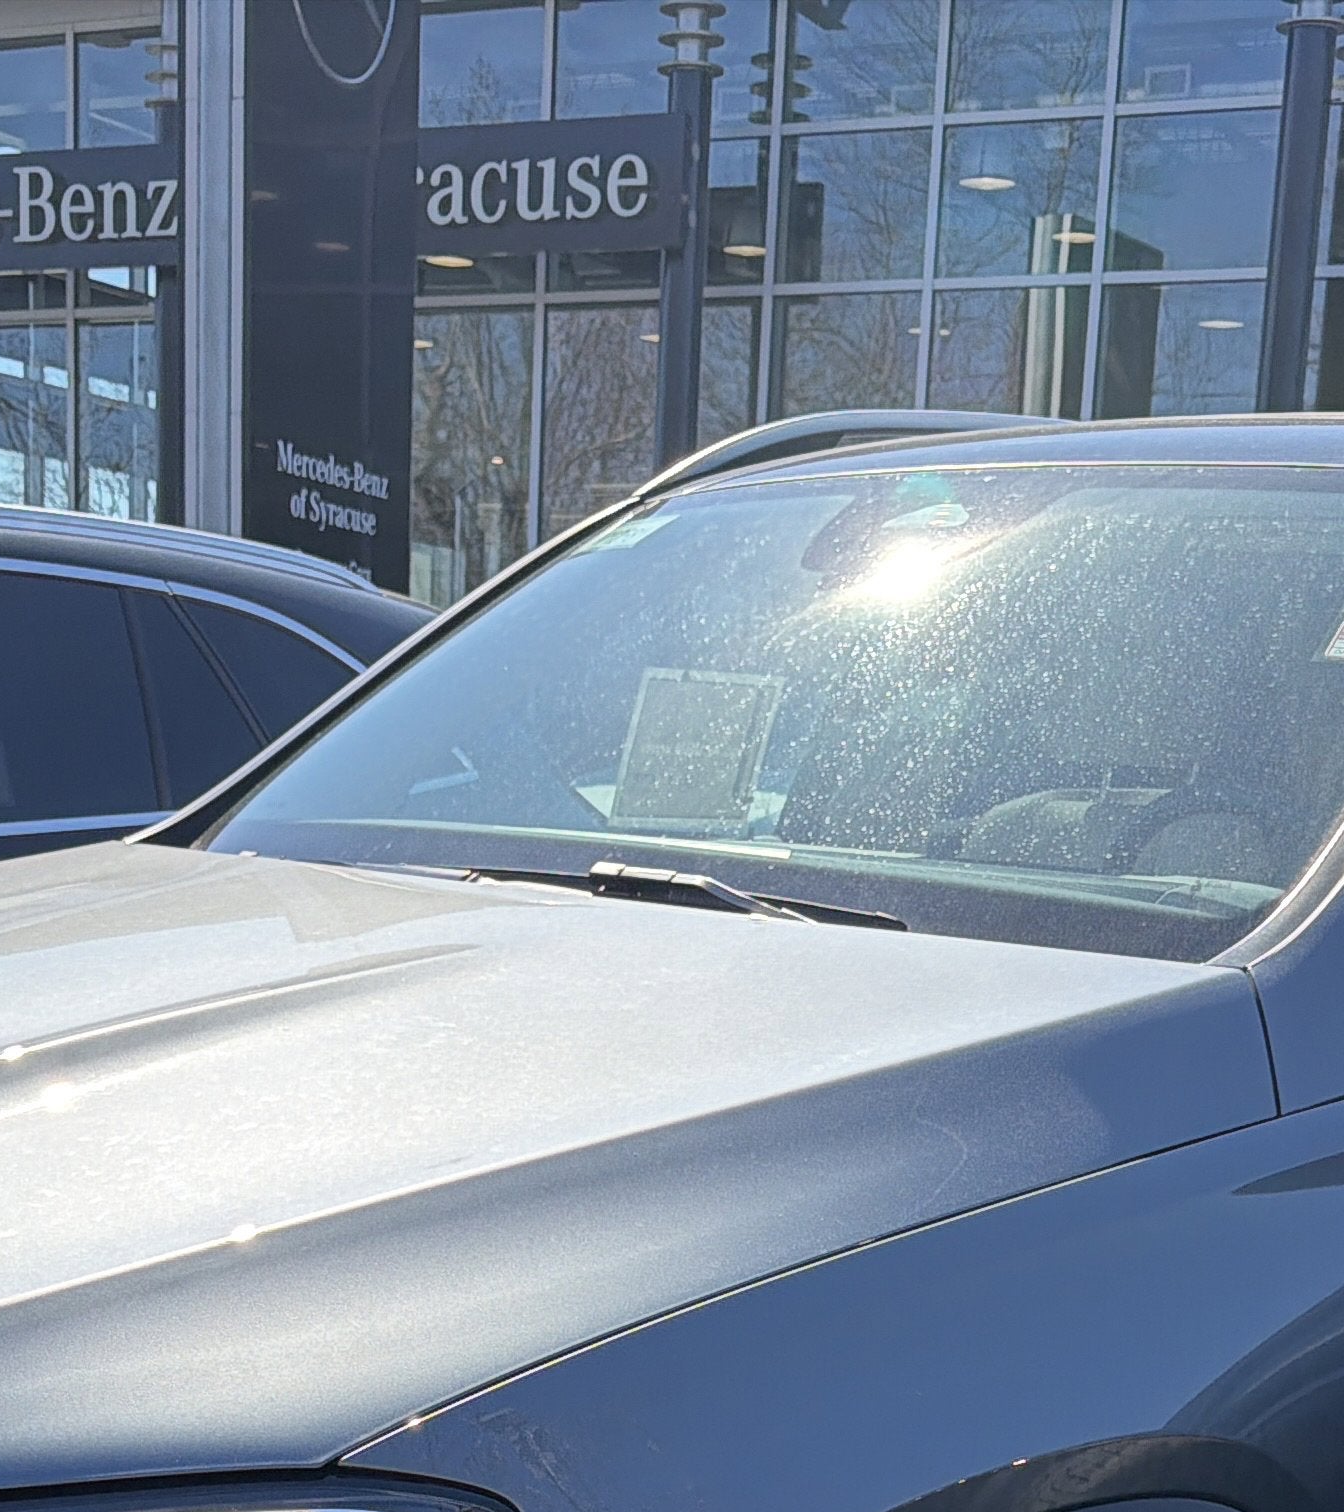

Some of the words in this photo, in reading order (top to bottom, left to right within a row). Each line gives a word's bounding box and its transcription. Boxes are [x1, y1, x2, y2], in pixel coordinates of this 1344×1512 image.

[416, 153, 648, 226] acuse
[277, 439, 390, 500] Mercedes-Benz
[290, 488, 308, 520] of
[309, 490, 377, 536] Syracuse
